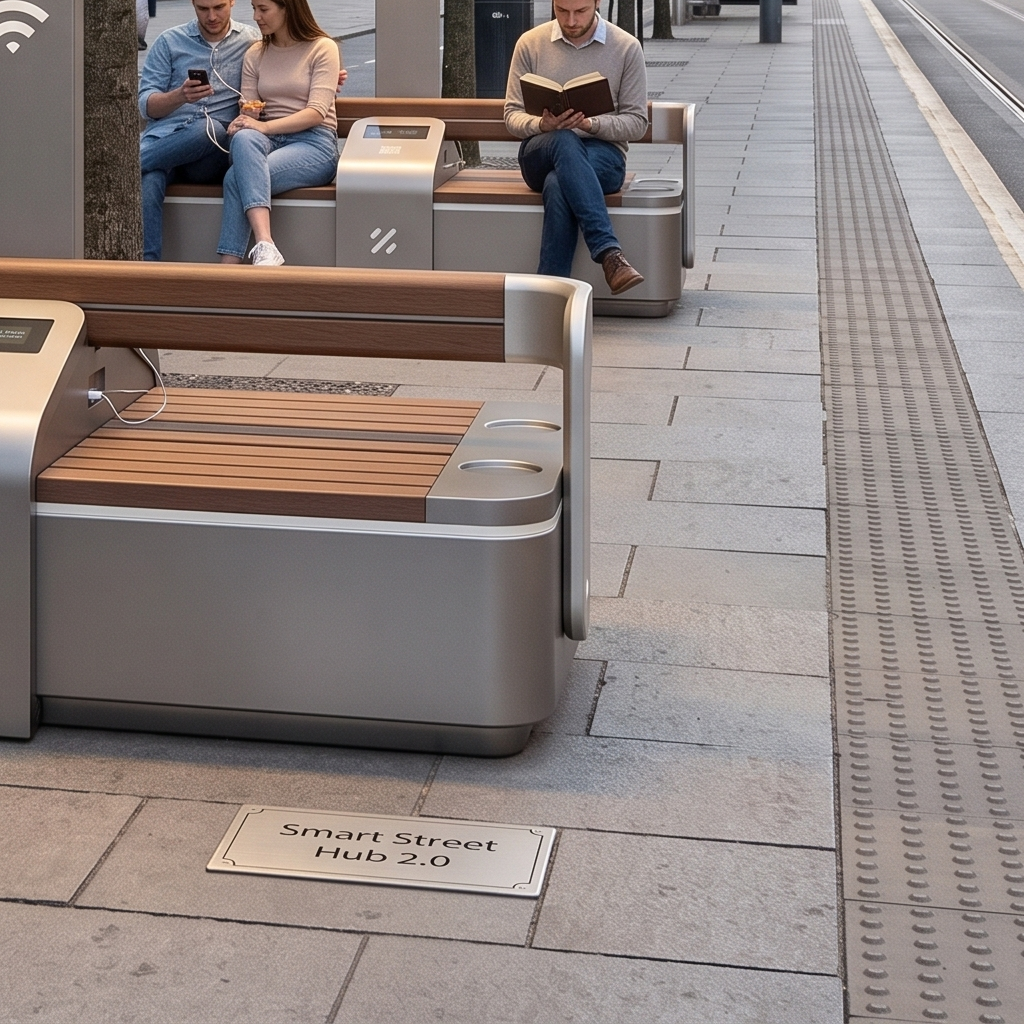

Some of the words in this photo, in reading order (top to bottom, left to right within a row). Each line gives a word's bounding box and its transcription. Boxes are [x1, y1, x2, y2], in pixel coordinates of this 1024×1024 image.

[279, 823, 384, 843] Smart
[392, 832, 498, 852] Street
[314, 845, 388, 863] Hub
[396, 852, 451, 868] 2.0
